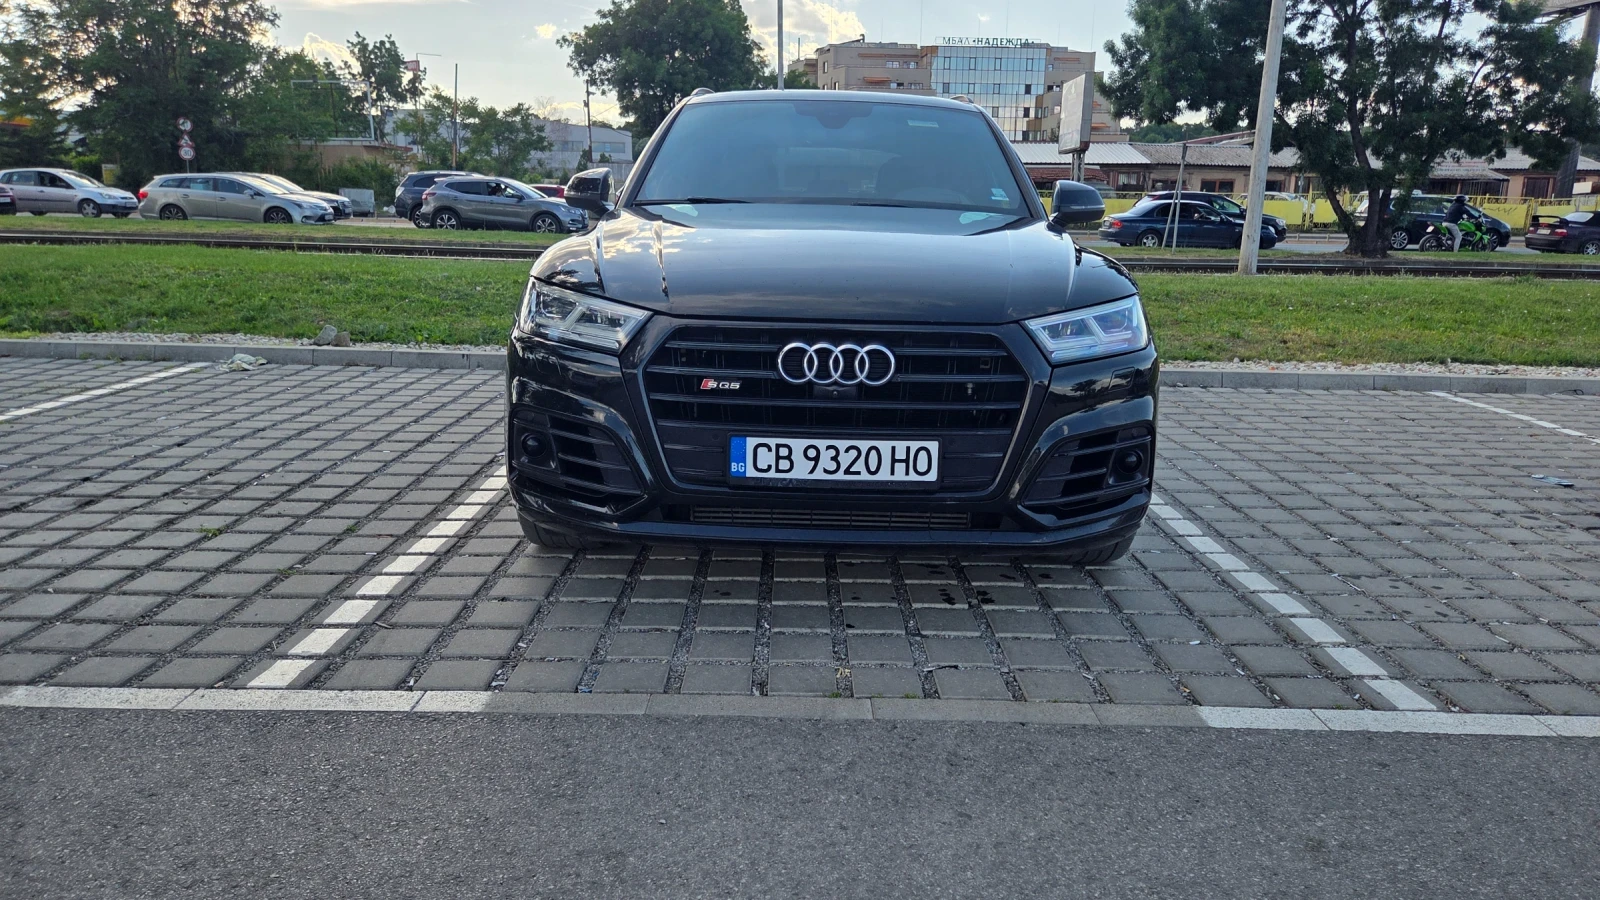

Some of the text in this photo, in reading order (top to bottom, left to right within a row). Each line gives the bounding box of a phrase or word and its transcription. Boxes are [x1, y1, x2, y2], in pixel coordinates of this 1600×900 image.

[942, 36, 970, 45] МБАЛ
[700, 378, 741, 390] SQ5
[752, 442, 933, 476] CB 9320 HO
[731, 462, 745, 472] BG
